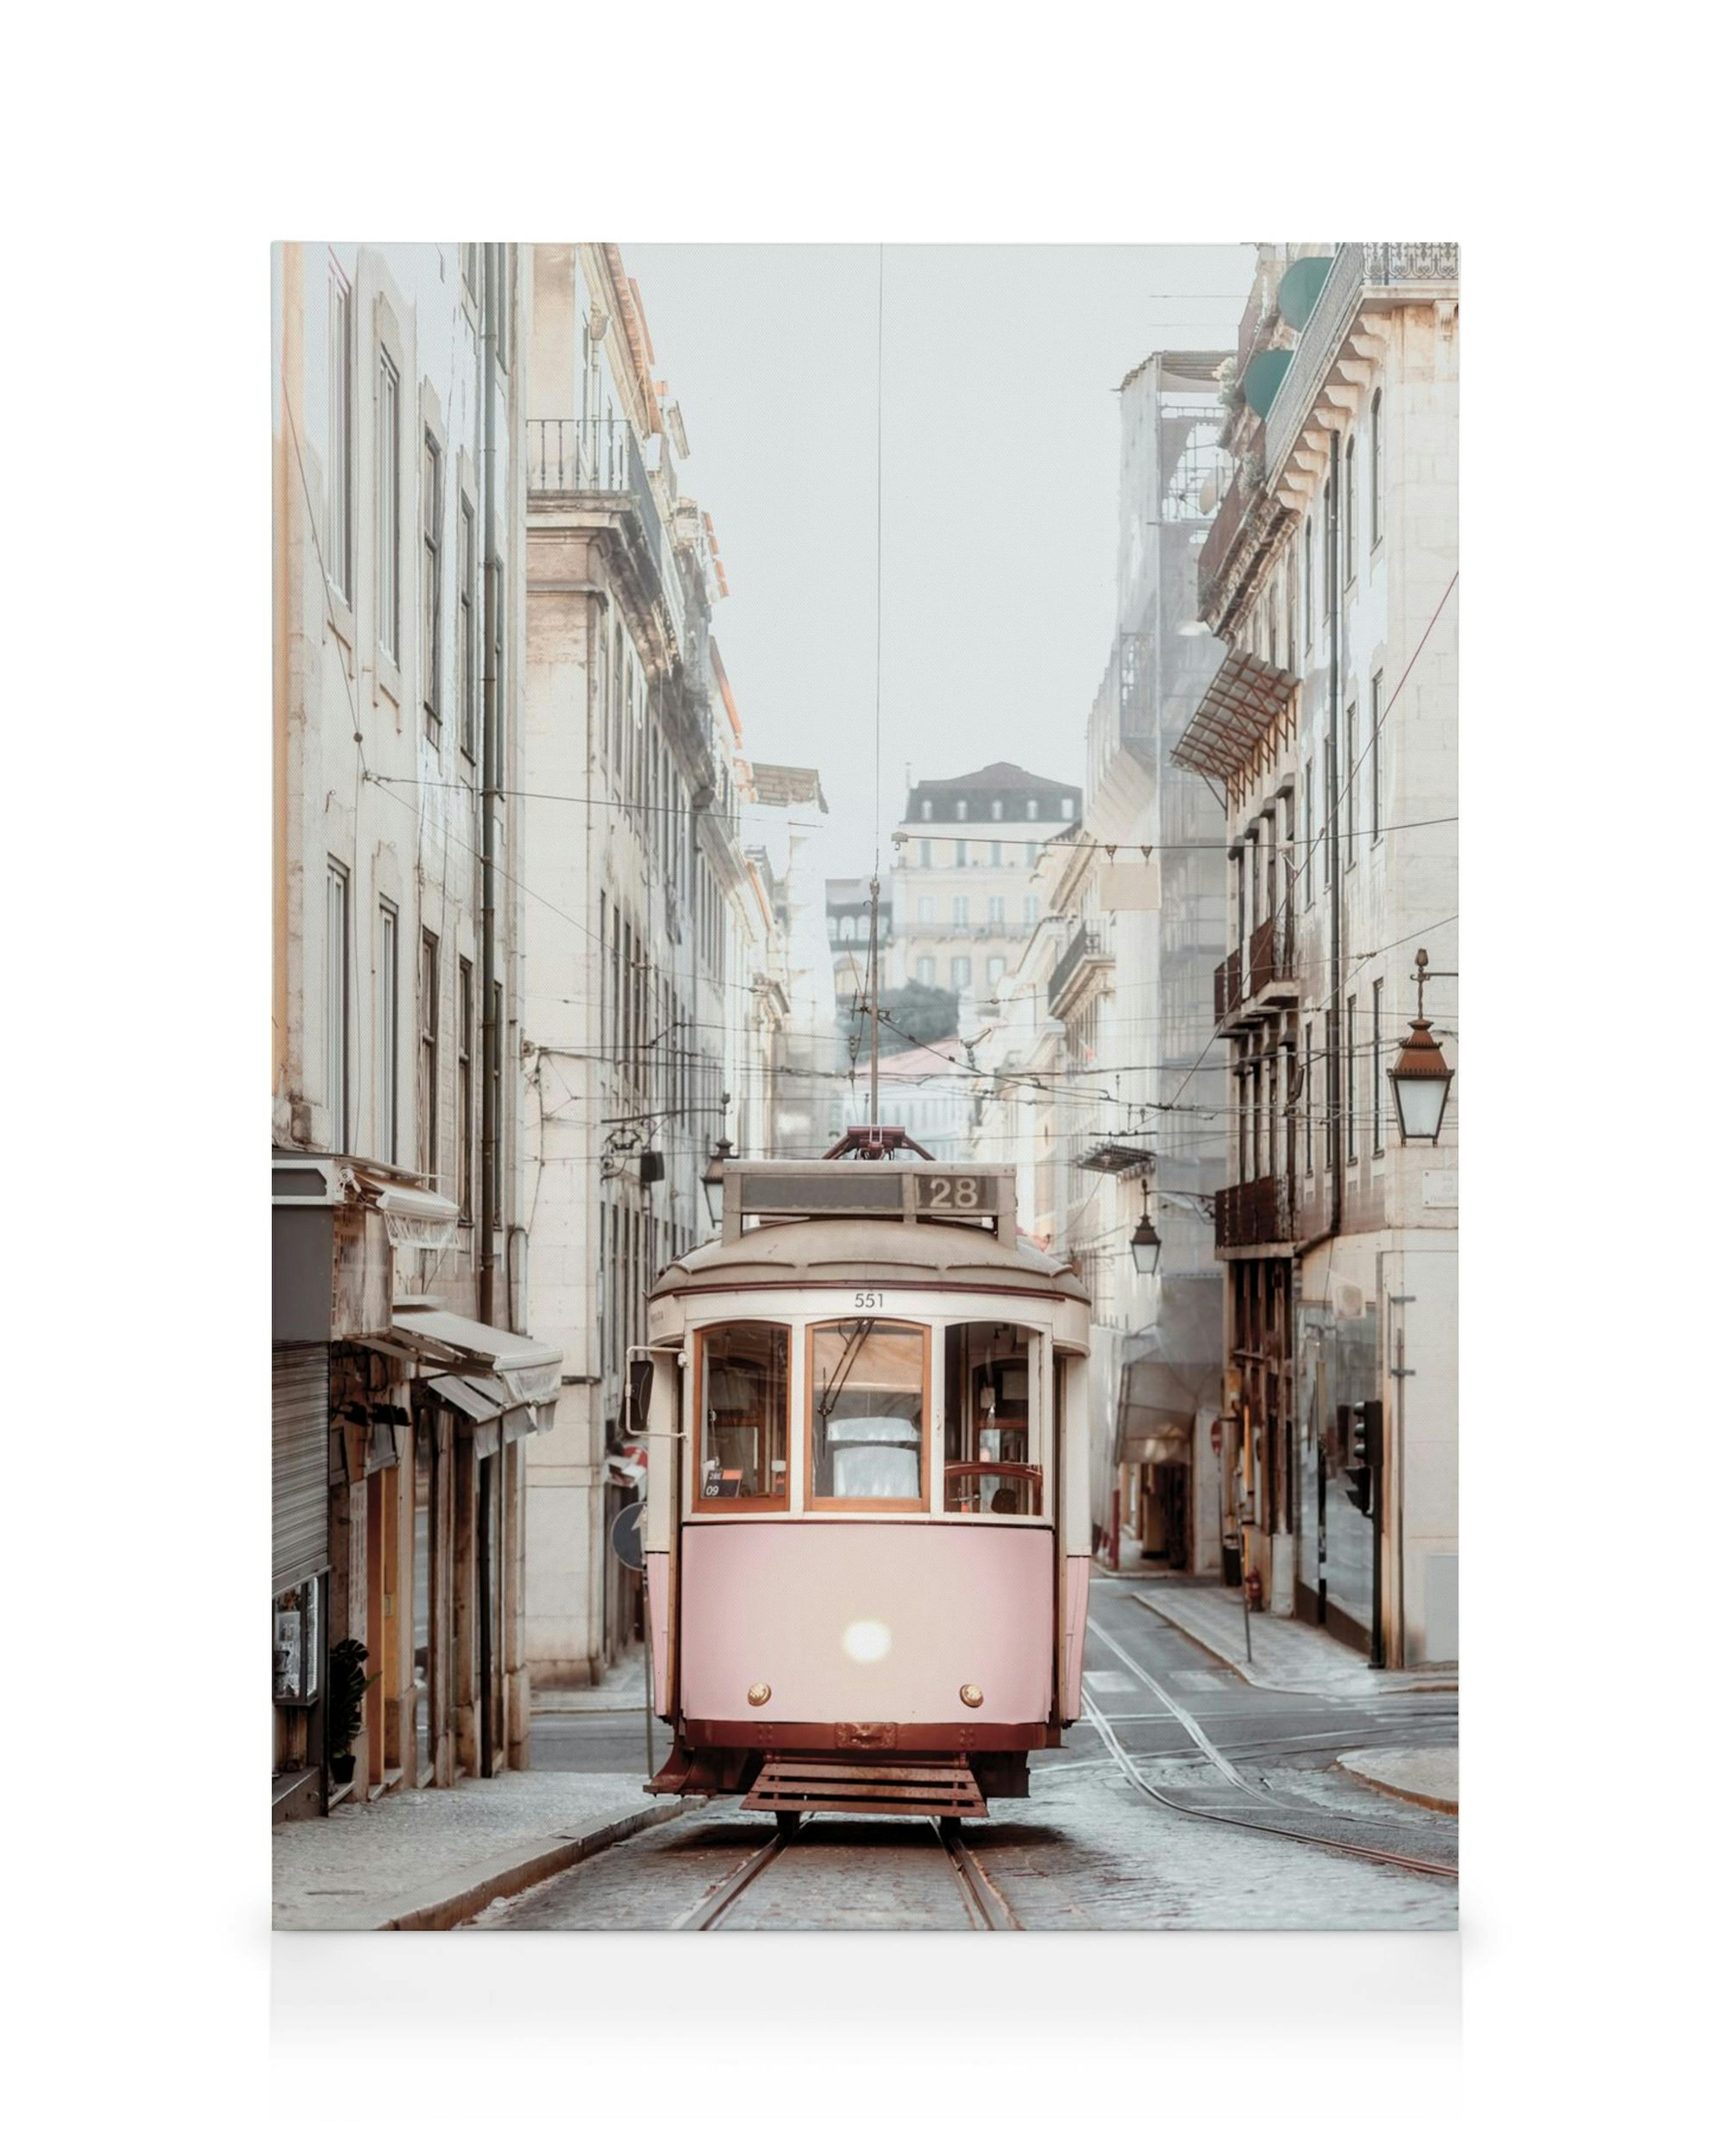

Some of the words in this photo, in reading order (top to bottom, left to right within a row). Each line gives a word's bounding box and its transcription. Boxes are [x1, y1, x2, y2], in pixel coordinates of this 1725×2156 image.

[929, 1177, 978, 1208] 28
[854, 1293, 883, 1308] 551
[706, 1485, 719, 1496] 09
